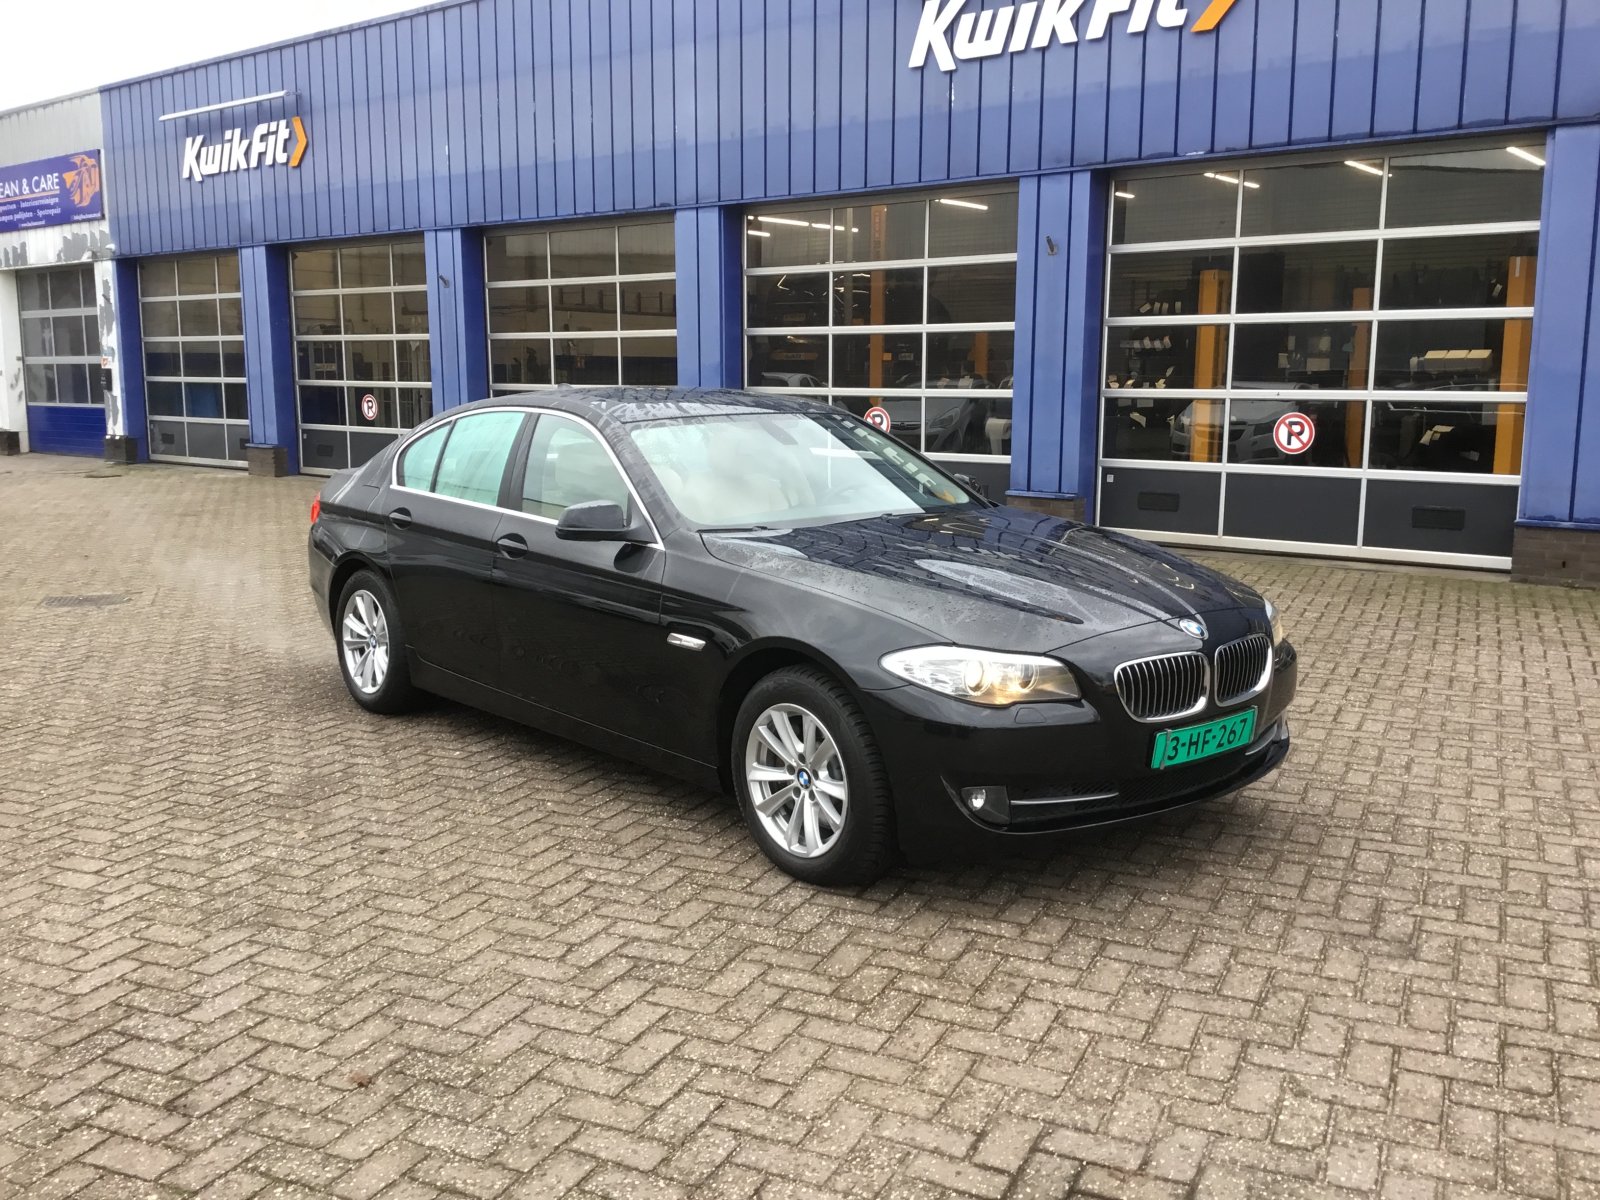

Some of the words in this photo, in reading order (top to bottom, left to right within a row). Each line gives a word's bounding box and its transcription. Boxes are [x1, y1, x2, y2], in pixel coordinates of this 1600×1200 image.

[22, 178, 30, 195] &
[32, 173, 60, 192] CARE
[1167, 717, 1249, 761] 3-HF-267
